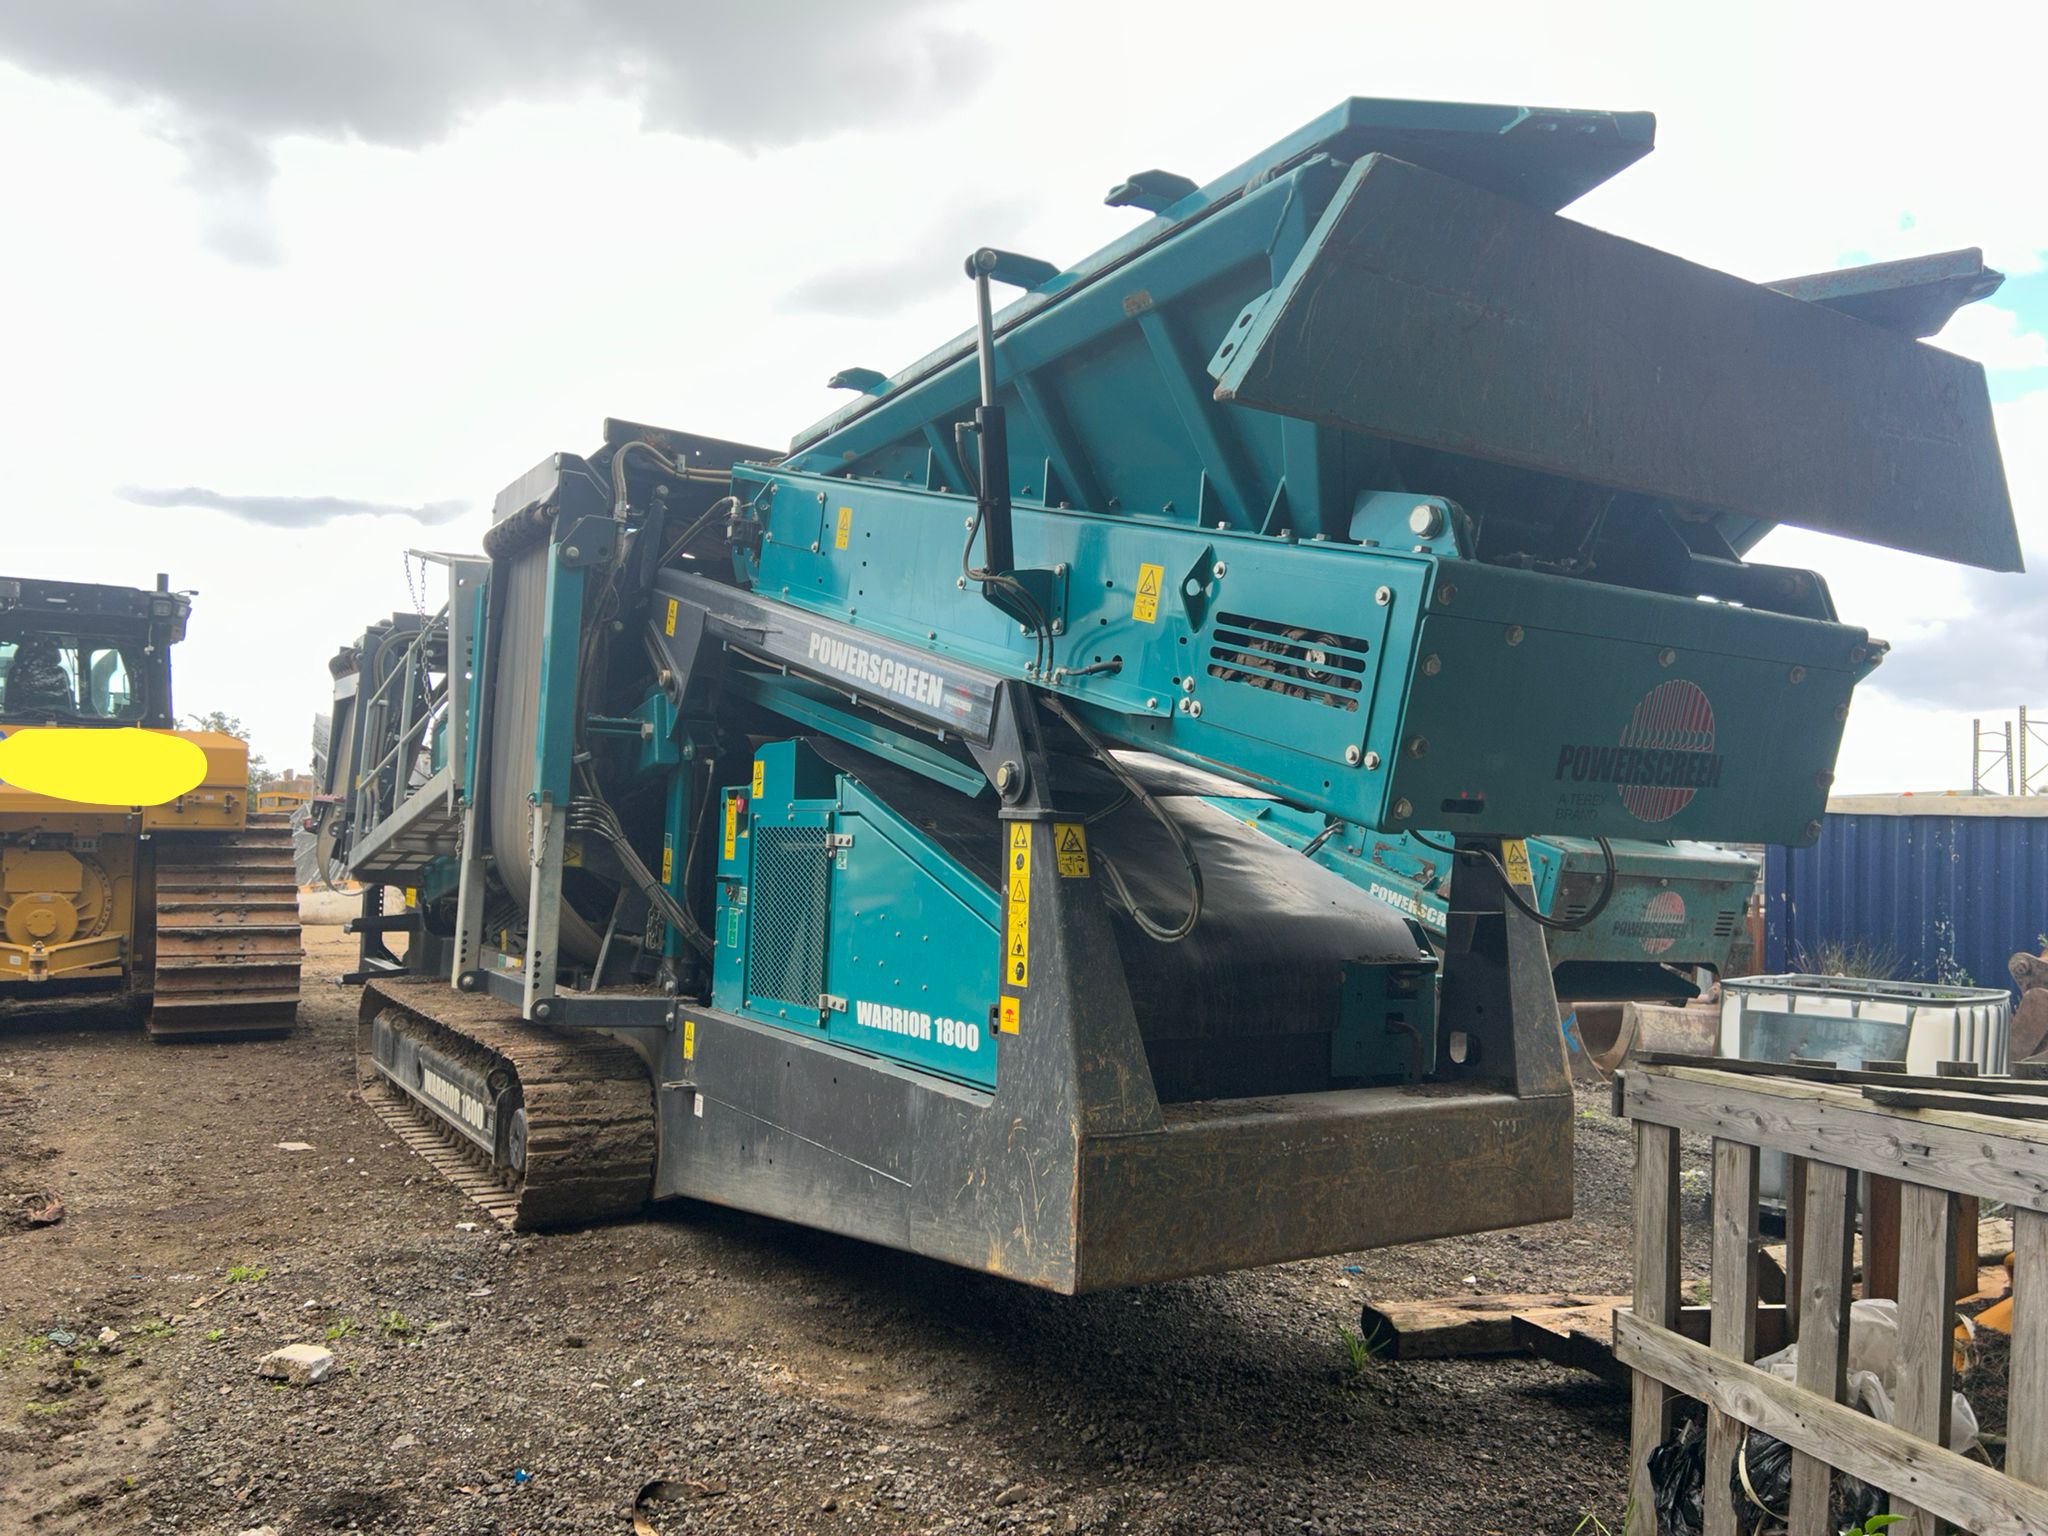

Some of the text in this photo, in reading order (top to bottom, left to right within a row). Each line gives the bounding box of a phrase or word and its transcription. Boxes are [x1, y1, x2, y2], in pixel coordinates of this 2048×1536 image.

[808, 631, 944, 708] POWERSCREEN
[1555, 743, 1724, 789] POWERSCREEN
[1555, 808, 1599, 821] BRAND
[1369, 882, 1447, 928] POWERSCR
[856, 1000, 980, 1052] WARRIOR 1800
[461, 1093, 484, 1131] 1800
